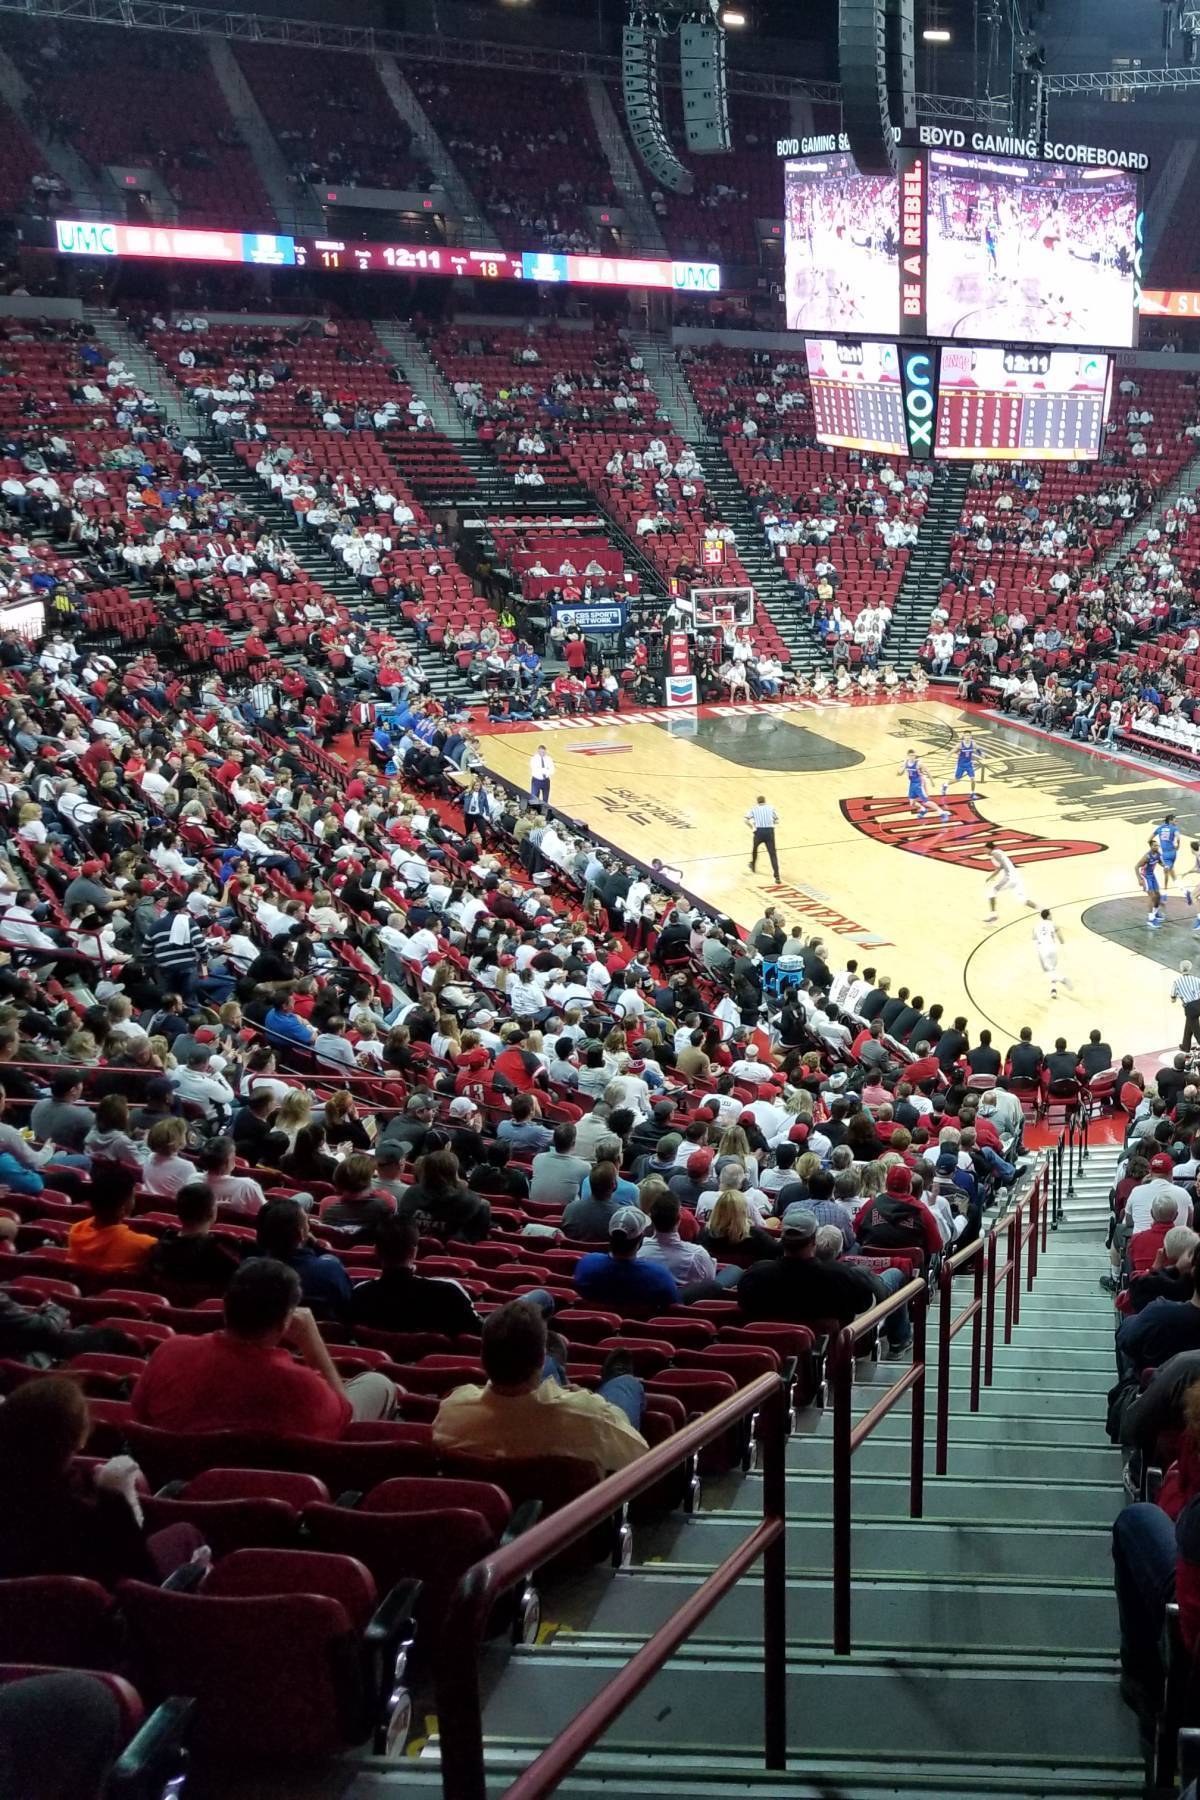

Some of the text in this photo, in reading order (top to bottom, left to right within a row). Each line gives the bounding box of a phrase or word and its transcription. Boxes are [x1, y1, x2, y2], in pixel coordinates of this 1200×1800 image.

[777, 139, 799, 156] BOYD
[801, 137, 836, 154] GAMING
[919, 126, 964, 147] BOYD
[972, 133, 1039, 157] GAMING
[1044, 142, 1149, 170] SCOREBOARD
[59, 225, 114, 252] UMC
[904, 160, 922, 315] BE A REBEL.
[322, 252, 338, 267] 11
[360, 258, 368, 269] 2
[383, 248, 440, 268] 12:11
[480, 262, 498, 276] 18
[674, 266, 718, 289] UMC
[1005, 354, 1049, 373] 12:11
[906, 355, 933, 446] COX
[704, 549, 721, 563] 30
[707, 699, 851, 717] REBELS
[757, 884, 896, 950] TRKANIAN
